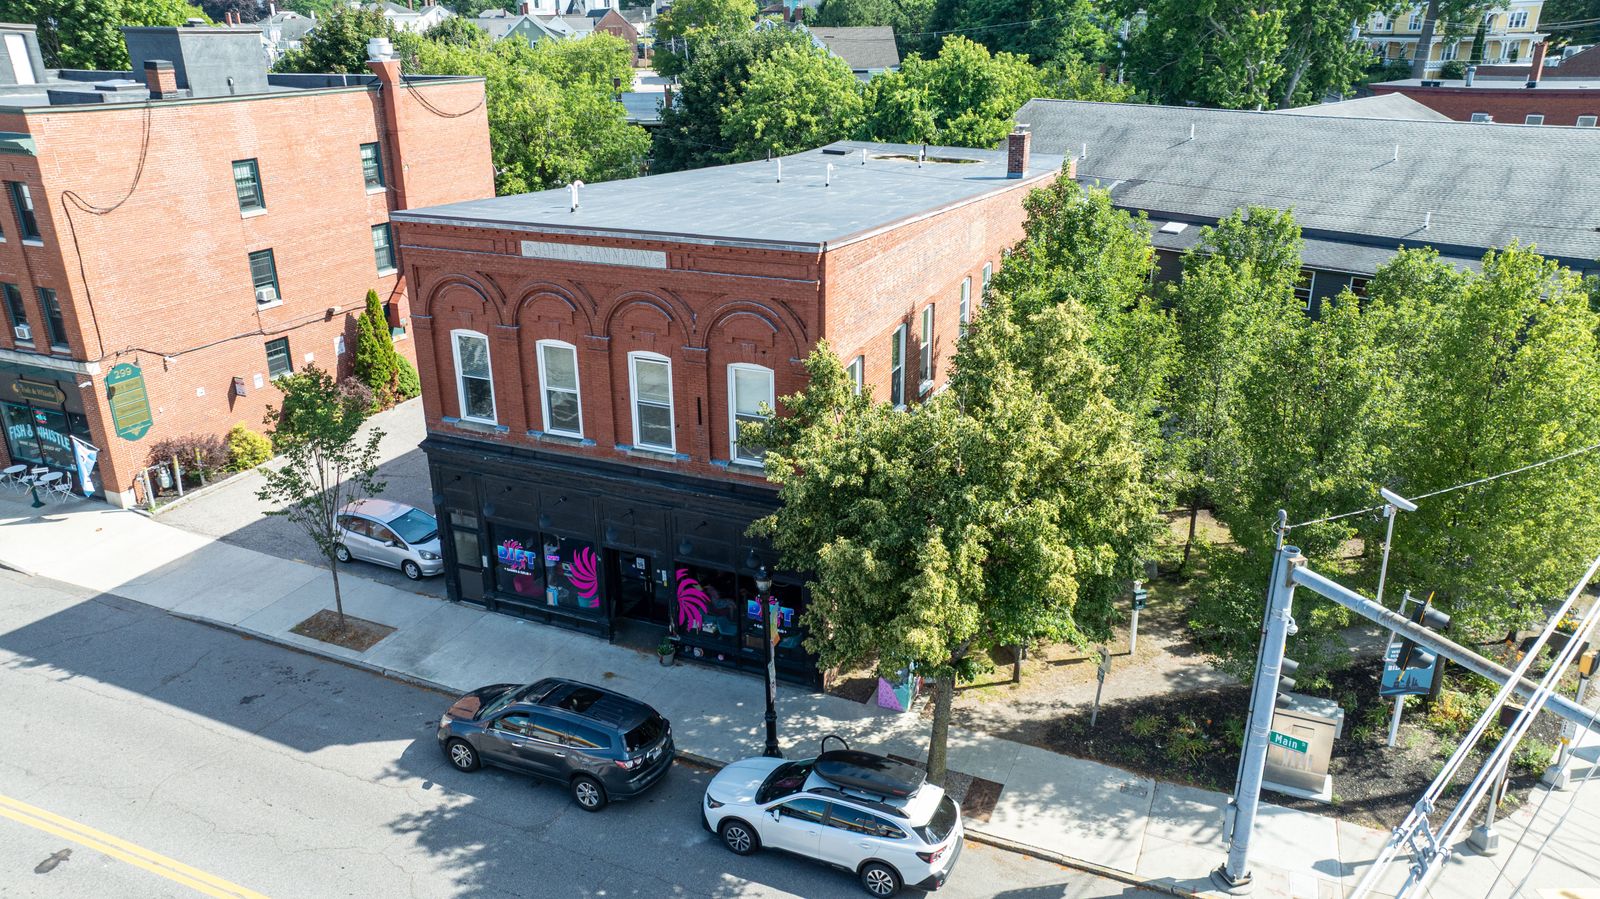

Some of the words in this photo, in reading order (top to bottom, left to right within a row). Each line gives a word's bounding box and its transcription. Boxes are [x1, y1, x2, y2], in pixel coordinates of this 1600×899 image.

[114, 367, 132, 379] 299
[9, 424, 26, 440] FISH
[27, 424, 33, 437] &
[37, 426, 71, 451] WHISTLE
[1275, 733, 1298, 749] Main
